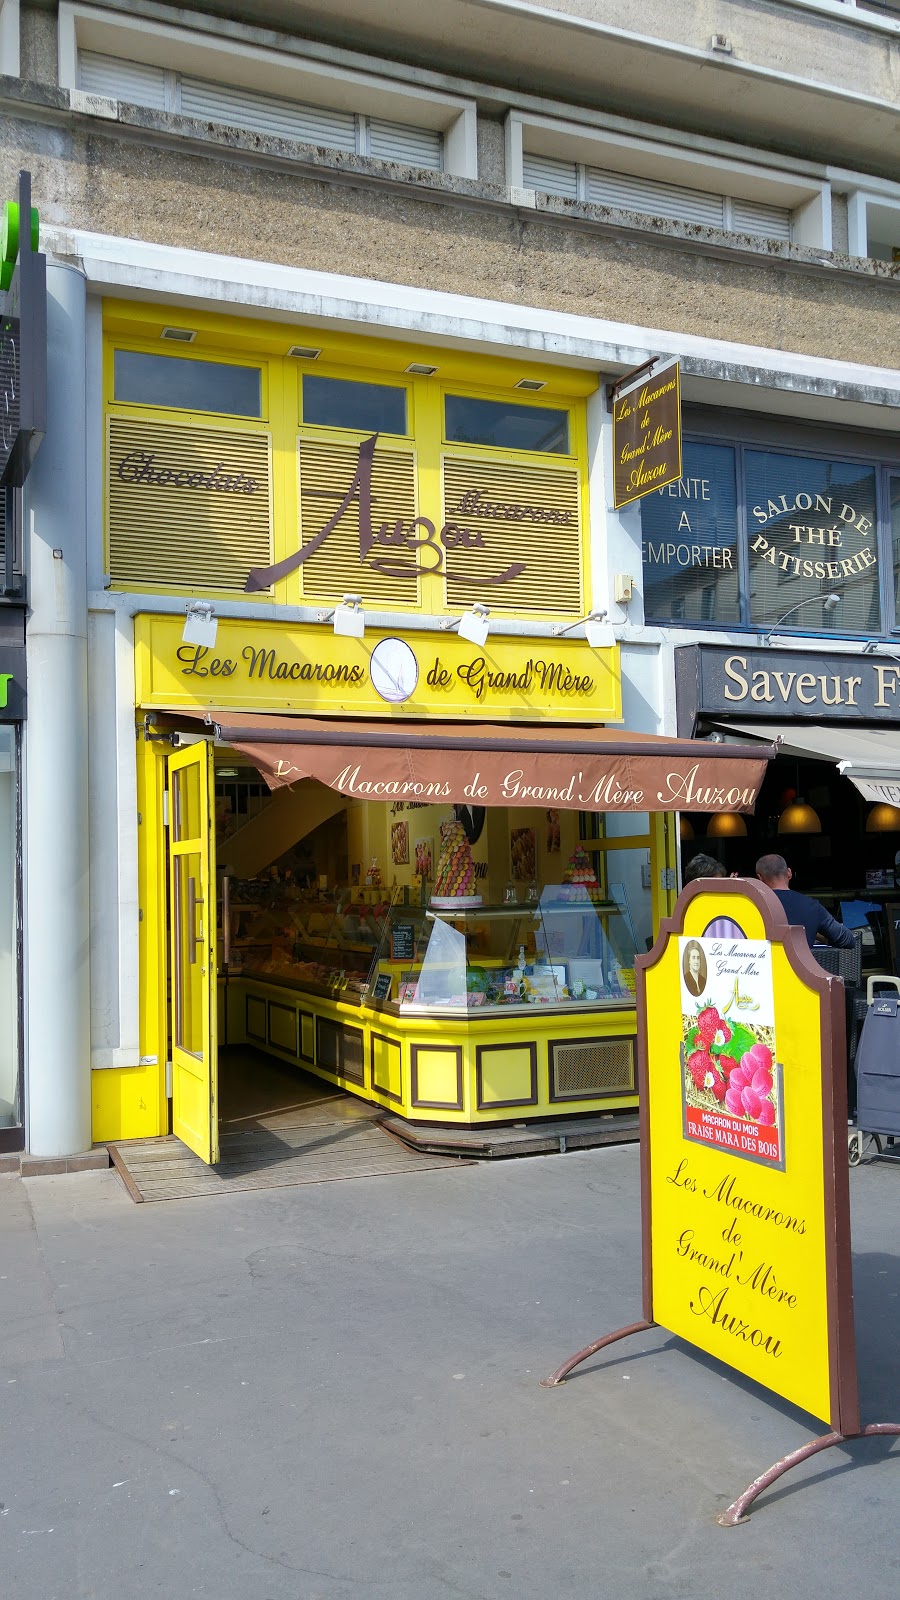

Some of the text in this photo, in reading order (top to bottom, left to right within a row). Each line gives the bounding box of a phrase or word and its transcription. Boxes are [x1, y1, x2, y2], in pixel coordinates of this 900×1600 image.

[616, 378, 677, 422] Les Macarons
[640, 410, 651, 429] de
[117, 451, 260, 494] Chocolats
[626, 458, 667, 492] Auzou
[243, 432, 527, 593] Auzou
[448, 488, 573, 526] Macarons
[677, 510, 692, 532] A
[752, 492, 873, 536] SALON DE
[788, 524, 843, 547] THÉ
[750, 534, 877, 580] PATISSERIE
[176, 644, 238, 678] Les
[242, 645, 365, 683] Macarons
[426, 657, 453, 686] de
[723, 655, 900, 708] Saveur F
[329, 764, 452, 797] Macarons
[463, 772, 489, 798] de
[656, 764, 756, 805] Auzou
[709, 942, 767, 959] Les Macarons de
[688, 1121, 778, 1158] FRAISE MARA DES BOIS
[702, 1113, 759, 1137] MACARON DU MOIS
[666, 1158, 807, 1235] Les Macarons
[721, 1217, 743, 1246] de
[689, 1286, 783, 1358] Auzou
